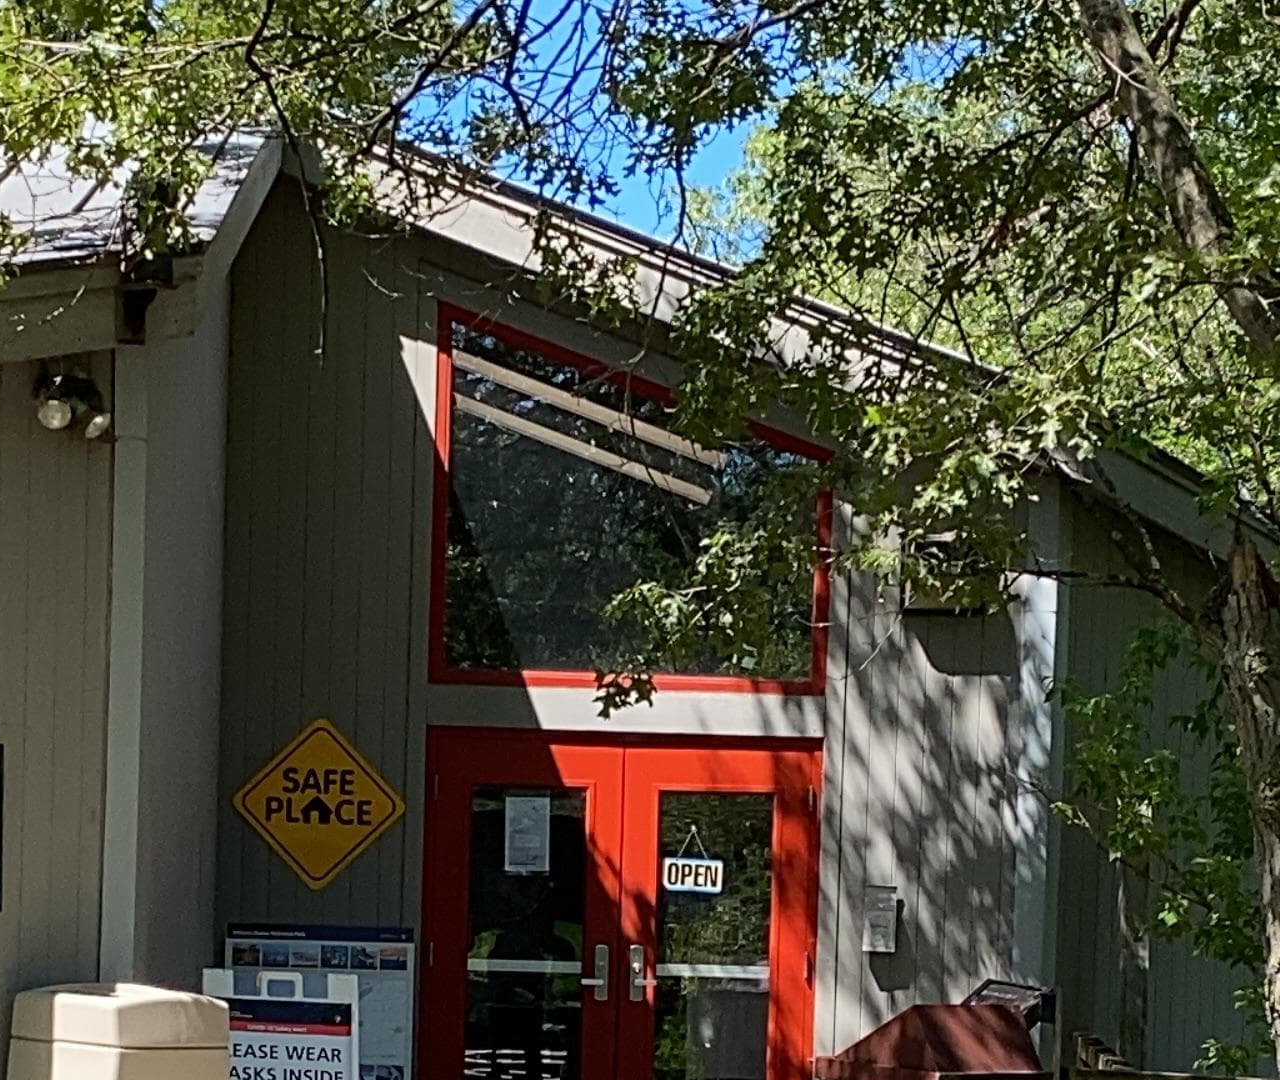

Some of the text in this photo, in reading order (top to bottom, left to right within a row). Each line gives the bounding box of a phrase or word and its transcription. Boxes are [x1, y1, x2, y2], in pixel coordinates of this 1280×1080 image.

[282, 767, 355, 795] SAFE
[667, 862, 718, 887] OPEN
[230, 1043, 342, 1063] EASE WEAR
